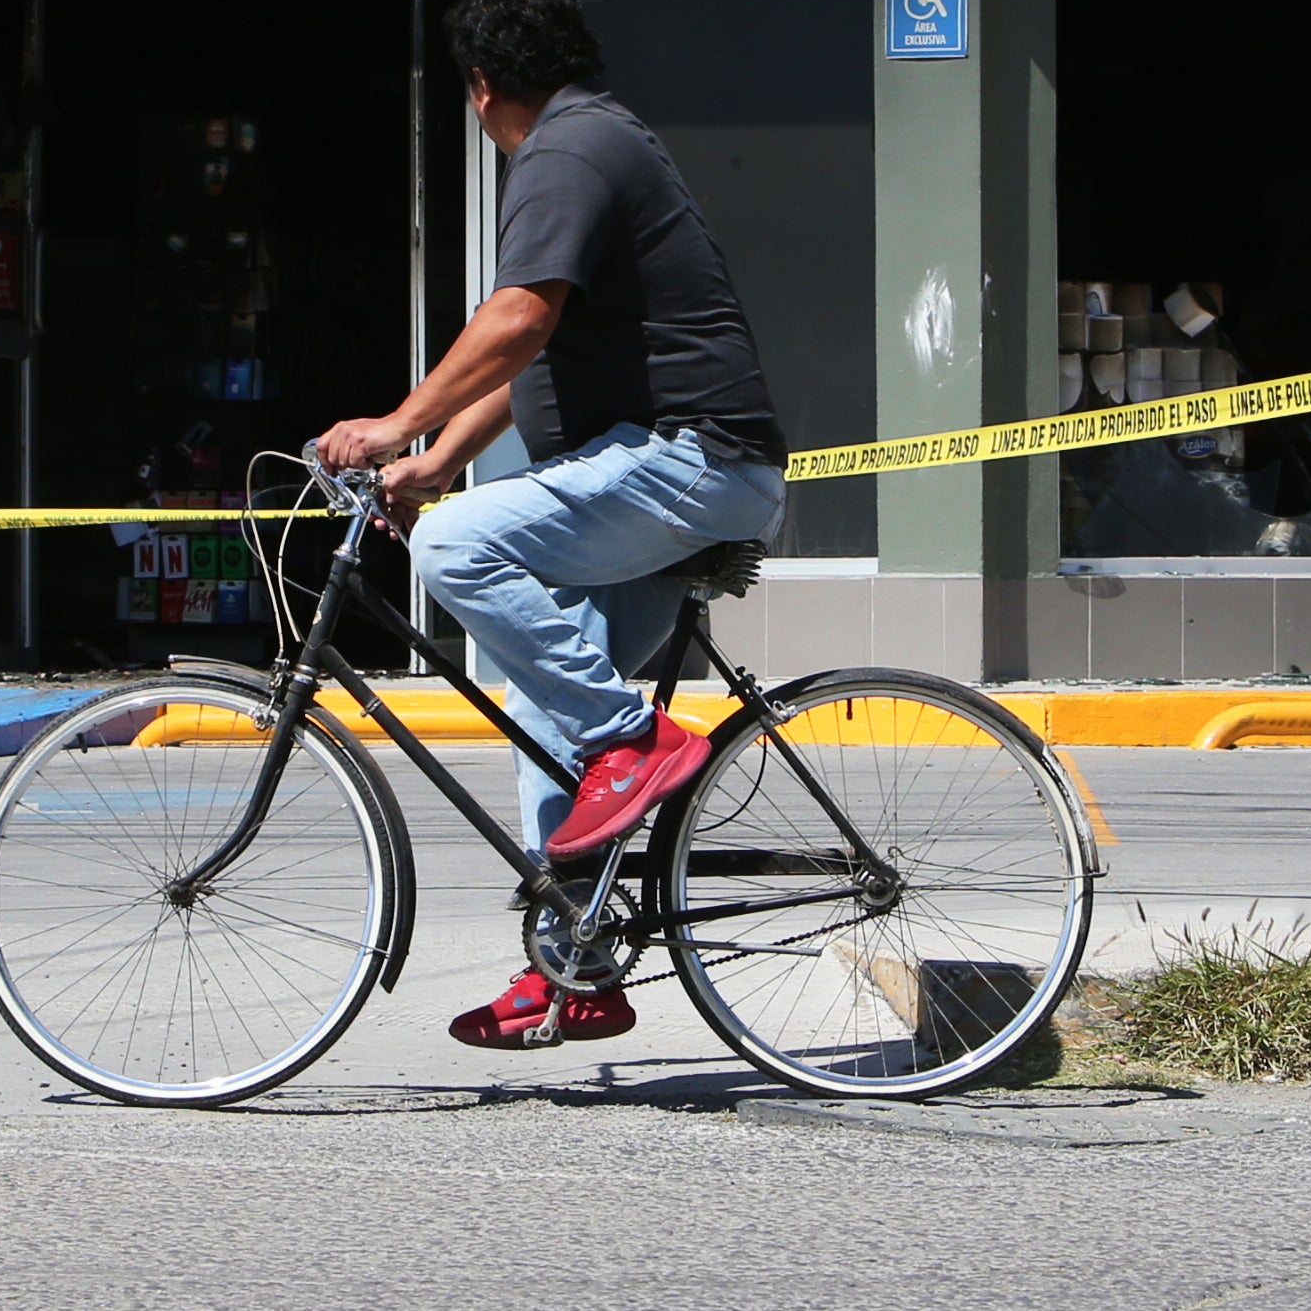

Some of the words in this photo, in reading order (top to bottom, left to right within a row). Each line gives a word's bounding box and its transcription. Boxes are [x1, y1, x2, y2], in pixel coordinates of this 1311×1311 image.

[904, 34, 947, 46] EXCLUSIVA
[914, 21, 937, 33] ÁREA
[789, 457, 808, 477] DE
[809, 451, 857, 475] POLICIA
[859, 441, 928, 468] PROHIBIDO
[930, 440, 945, 461] EL
[948, 434, 979, 458] PASO
[990, 428, 1026, 454] LINEA
[1029, 424, 1048, 448] DE
[1049, 417, 1096, 445] POLICIA
[1099, 405, 1166, 436] PROHIBIDO
[1169, 403, 1184, 428] EL
[1186, 396, 1218, 423] PASO
[1230, 389, 1264, 418] LINEA
[1267, 385, 1283, 412] DE
[140, 544, 154, 573] N
[168, 545, 183, 574] N
